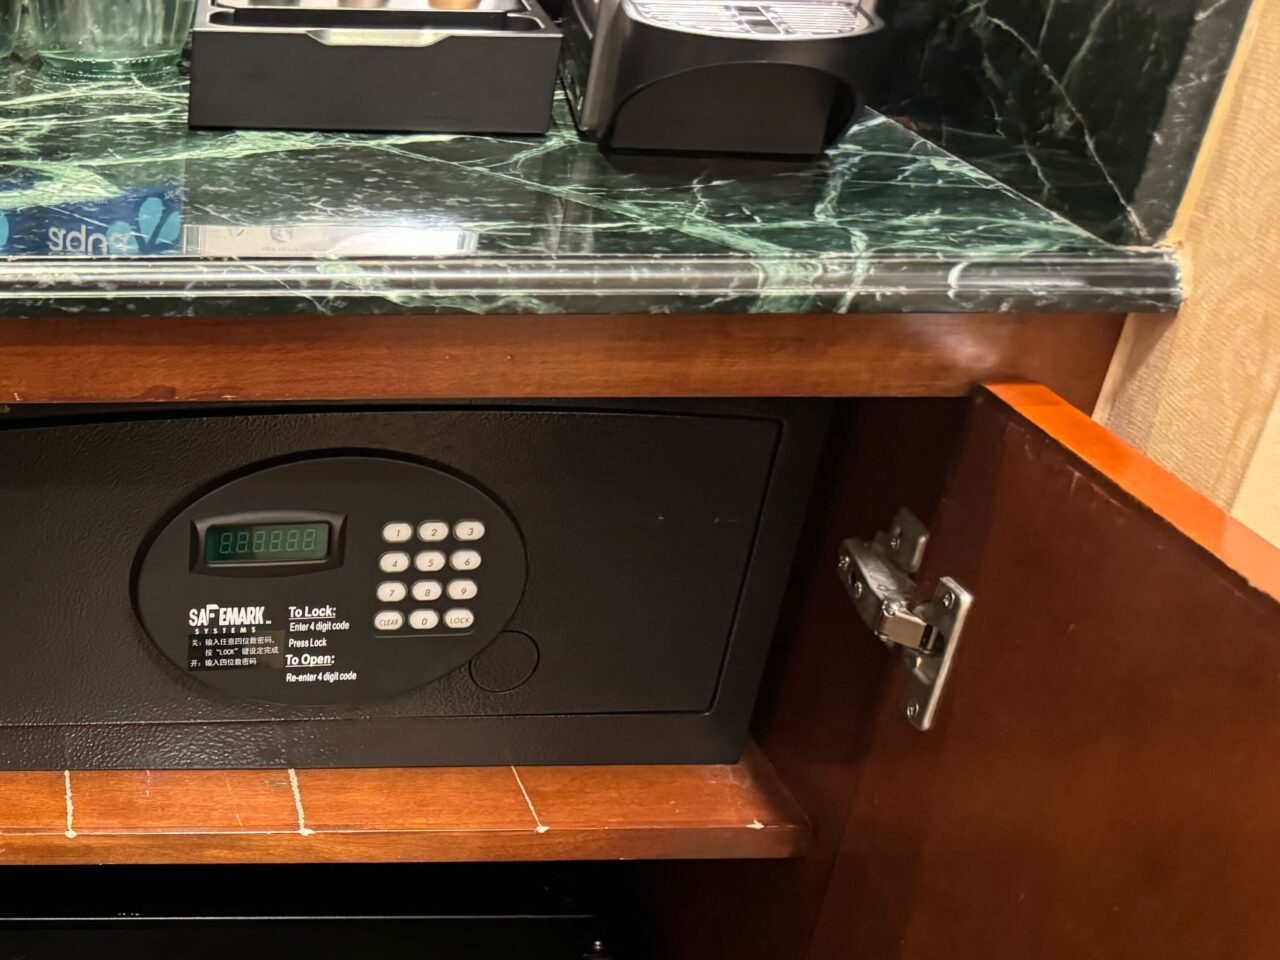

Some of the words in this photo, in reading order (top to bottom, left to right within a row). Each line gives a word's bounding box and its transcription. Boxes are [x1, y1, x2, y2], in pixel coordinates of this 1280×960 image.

[189, 604, 265, 626] SAFEMARK
[288, 606, 303, 617] To
[304, 605, 337, 617] Lock:
[289, 622, 309, 632] Enter
[315, 621, 332, 633] digit
[332, 620, 350, 631] code
[379, 619, 399, 627] CLEAR
[450, 617, 471, 625] LOCK
[288, 639, 309, 648] Press
[310, 638, 327, 648] Lock
[285, 655, 300, 666] To
[301, 653, 336, 667] Open:
[286, 672, 317, 683] Re-enter
[323, 671, 339, 683] digit
[339, 671, 357, 682] code
